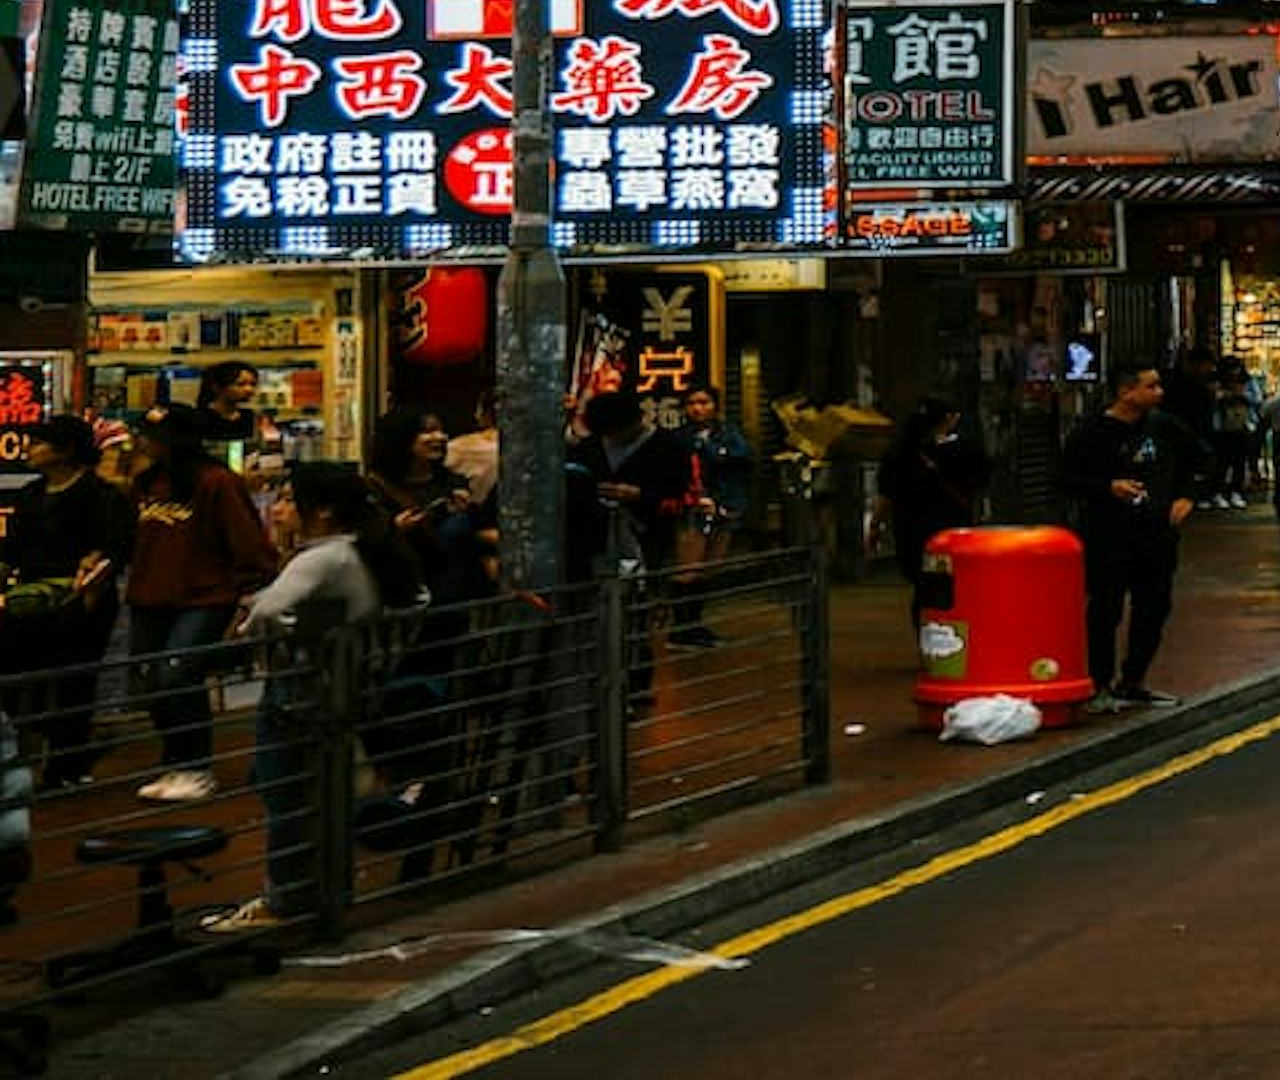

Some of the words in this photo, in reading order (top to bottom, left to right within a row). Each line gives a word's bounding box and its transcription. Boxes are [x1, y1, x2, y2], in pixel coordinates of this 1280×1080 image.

[228, 35, 771, 128] 中西大藥房
[1085, 54, 1262, 128] Hair
[850, 89, 996, 123] OTEL
[221, 132, 437, 174] 政府註冊
[32, 181, 91, 212] HOTEL
[93, 182, 140, 213] FREE
[141, 187, 174, 214] WIF
